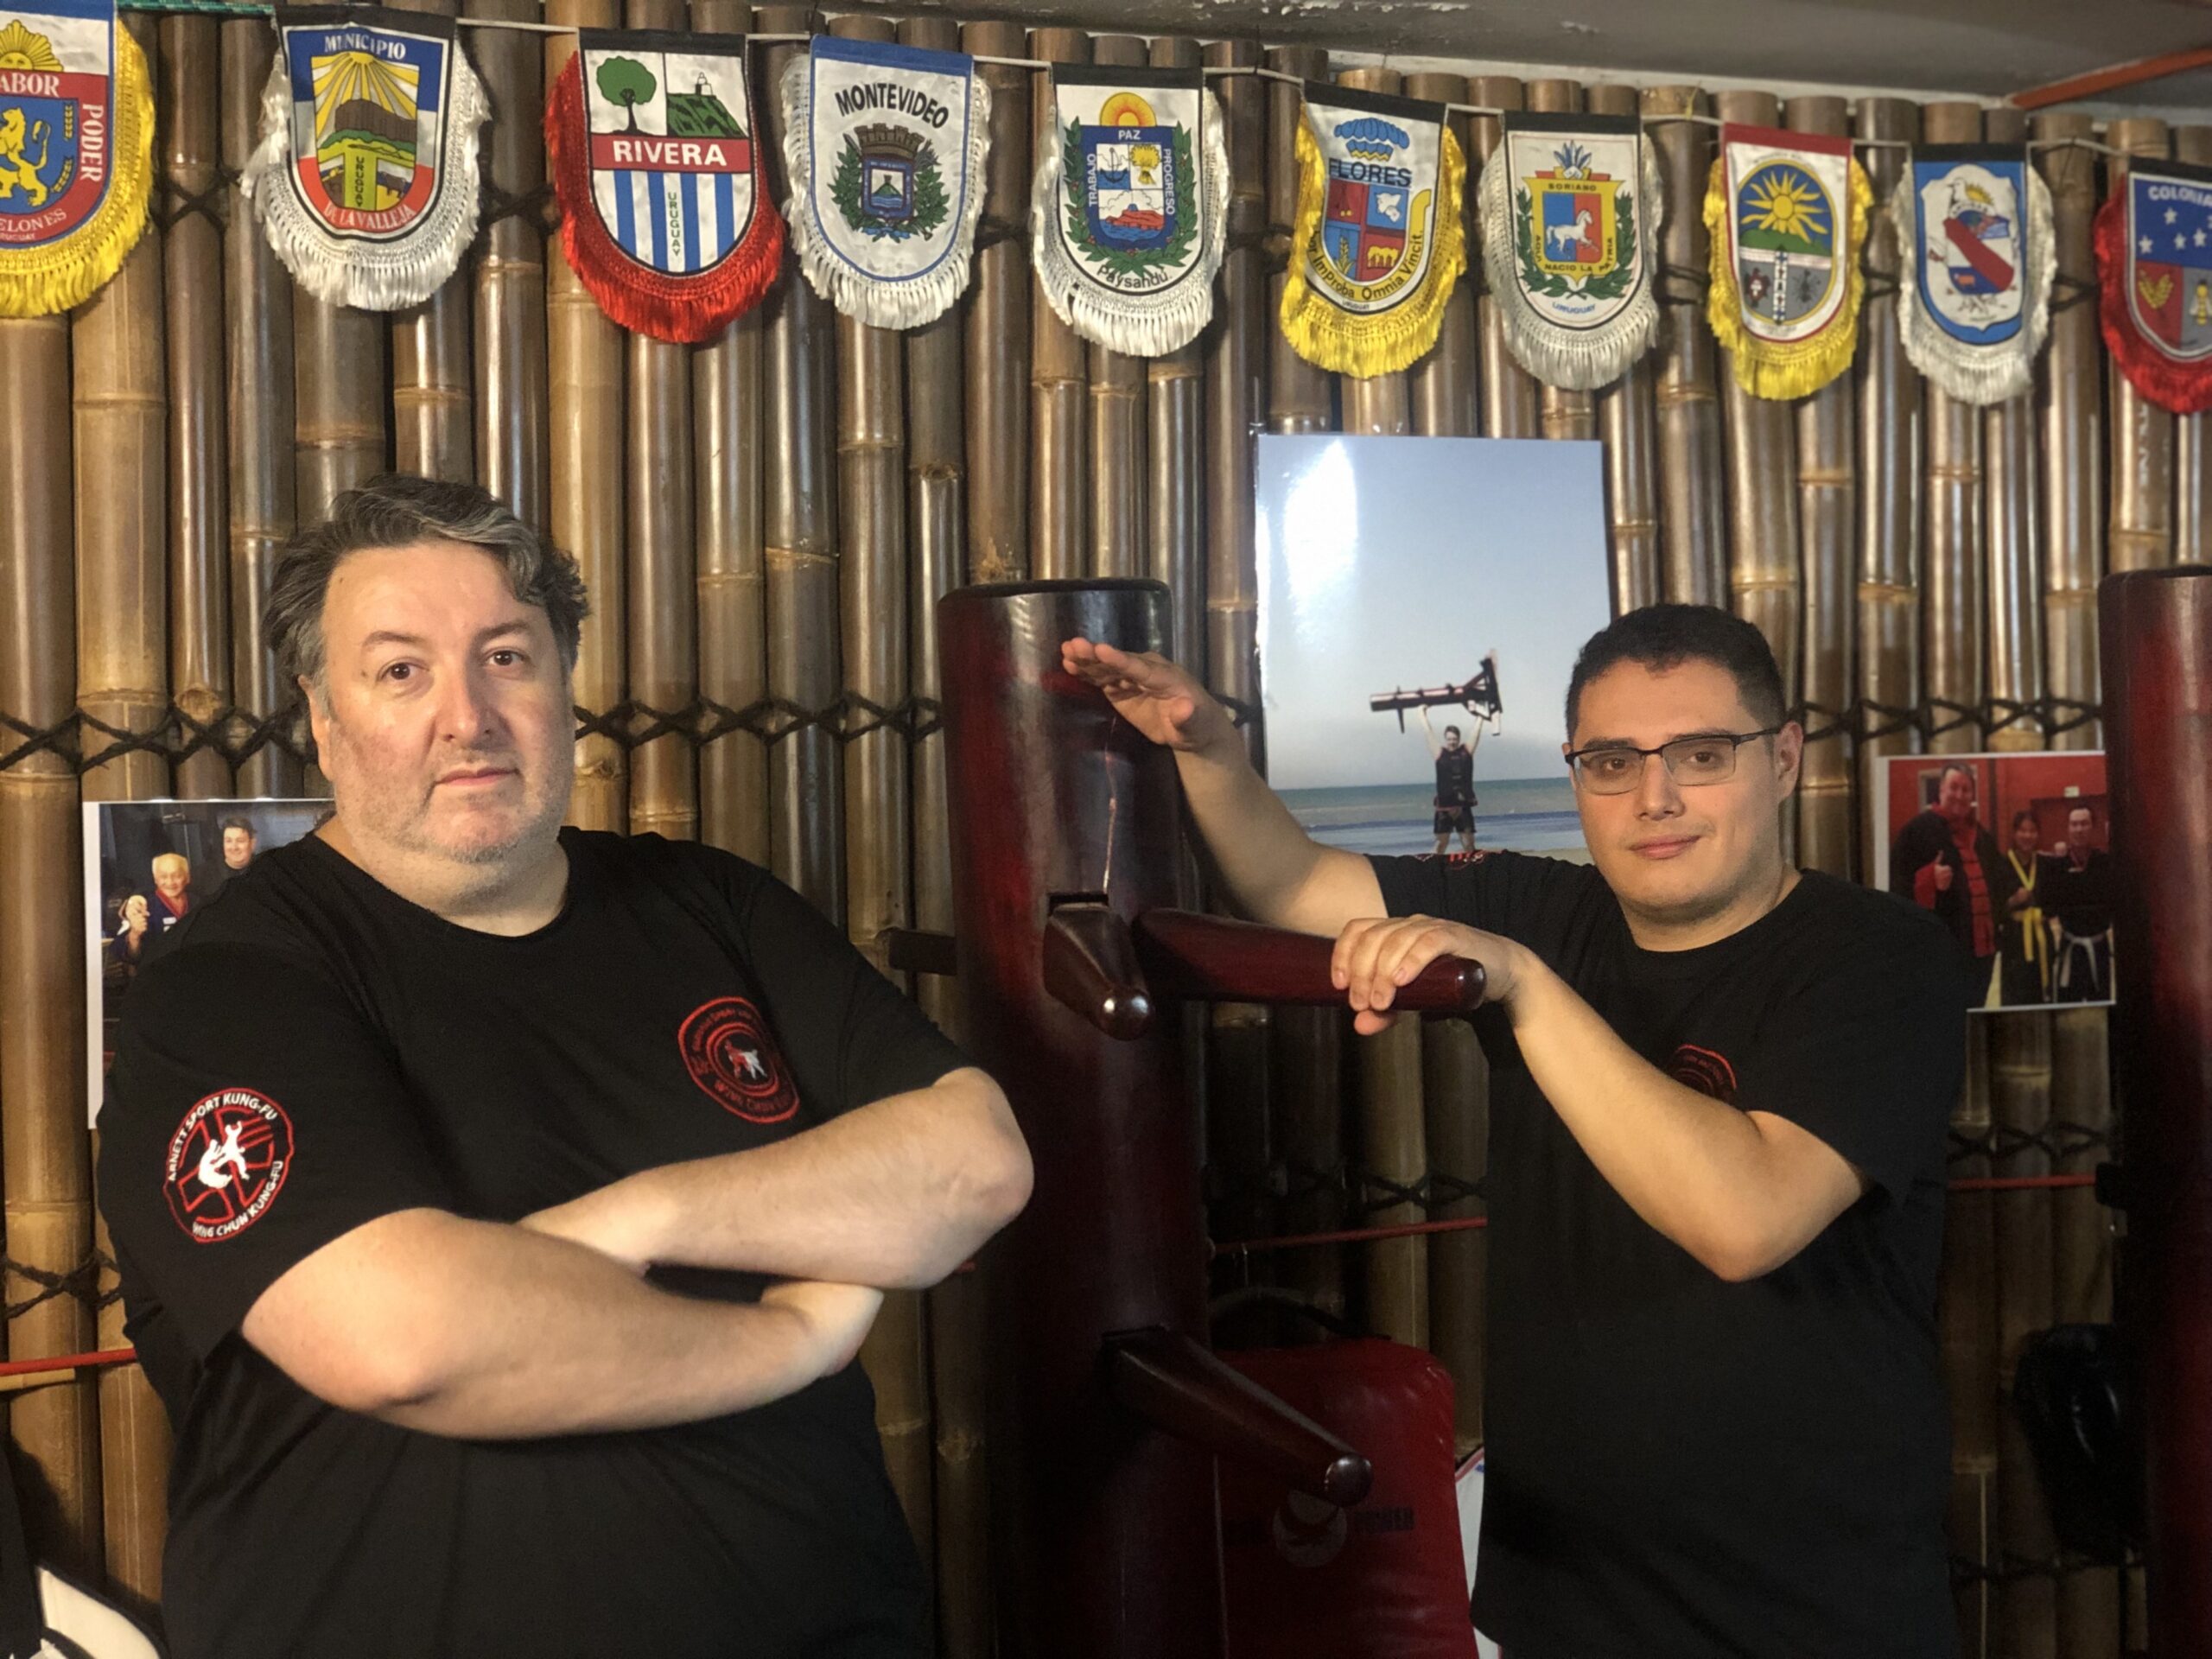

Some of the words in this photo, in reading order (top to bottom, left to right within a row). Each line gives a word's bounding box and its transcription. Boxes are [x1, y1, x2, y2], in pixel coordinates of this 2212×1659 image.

[324, 33, 406, 60] MUNICIPIO
[835, 83, 949, 129] MONTEVIDEO
[80, 104, 104, 182] PODER
[613, 140, 728, 166] RIVERA
[1118, 130, 1141, 140] PAZ
[355, 156, 365, 207] URUGUAY
[1086, 153, 1097, 207] TRABAJO
[1163, 149, 1175, 215] PROGRESO
[1329, 158, 1412, 188] FLORES
[1548, 183, 1597, 192] SORIANO
[668, 192, 681, 257] URUGUAY
[1361, 276, 1405, 301] Omnia
[186, 1096, 220, 1130] SPORT
[222, 1093, 277, 1121] KUNG-FU
[216, 1213, 248, 1236] CHUN
[246, 1160, 283, 1217] KUNG-FU
